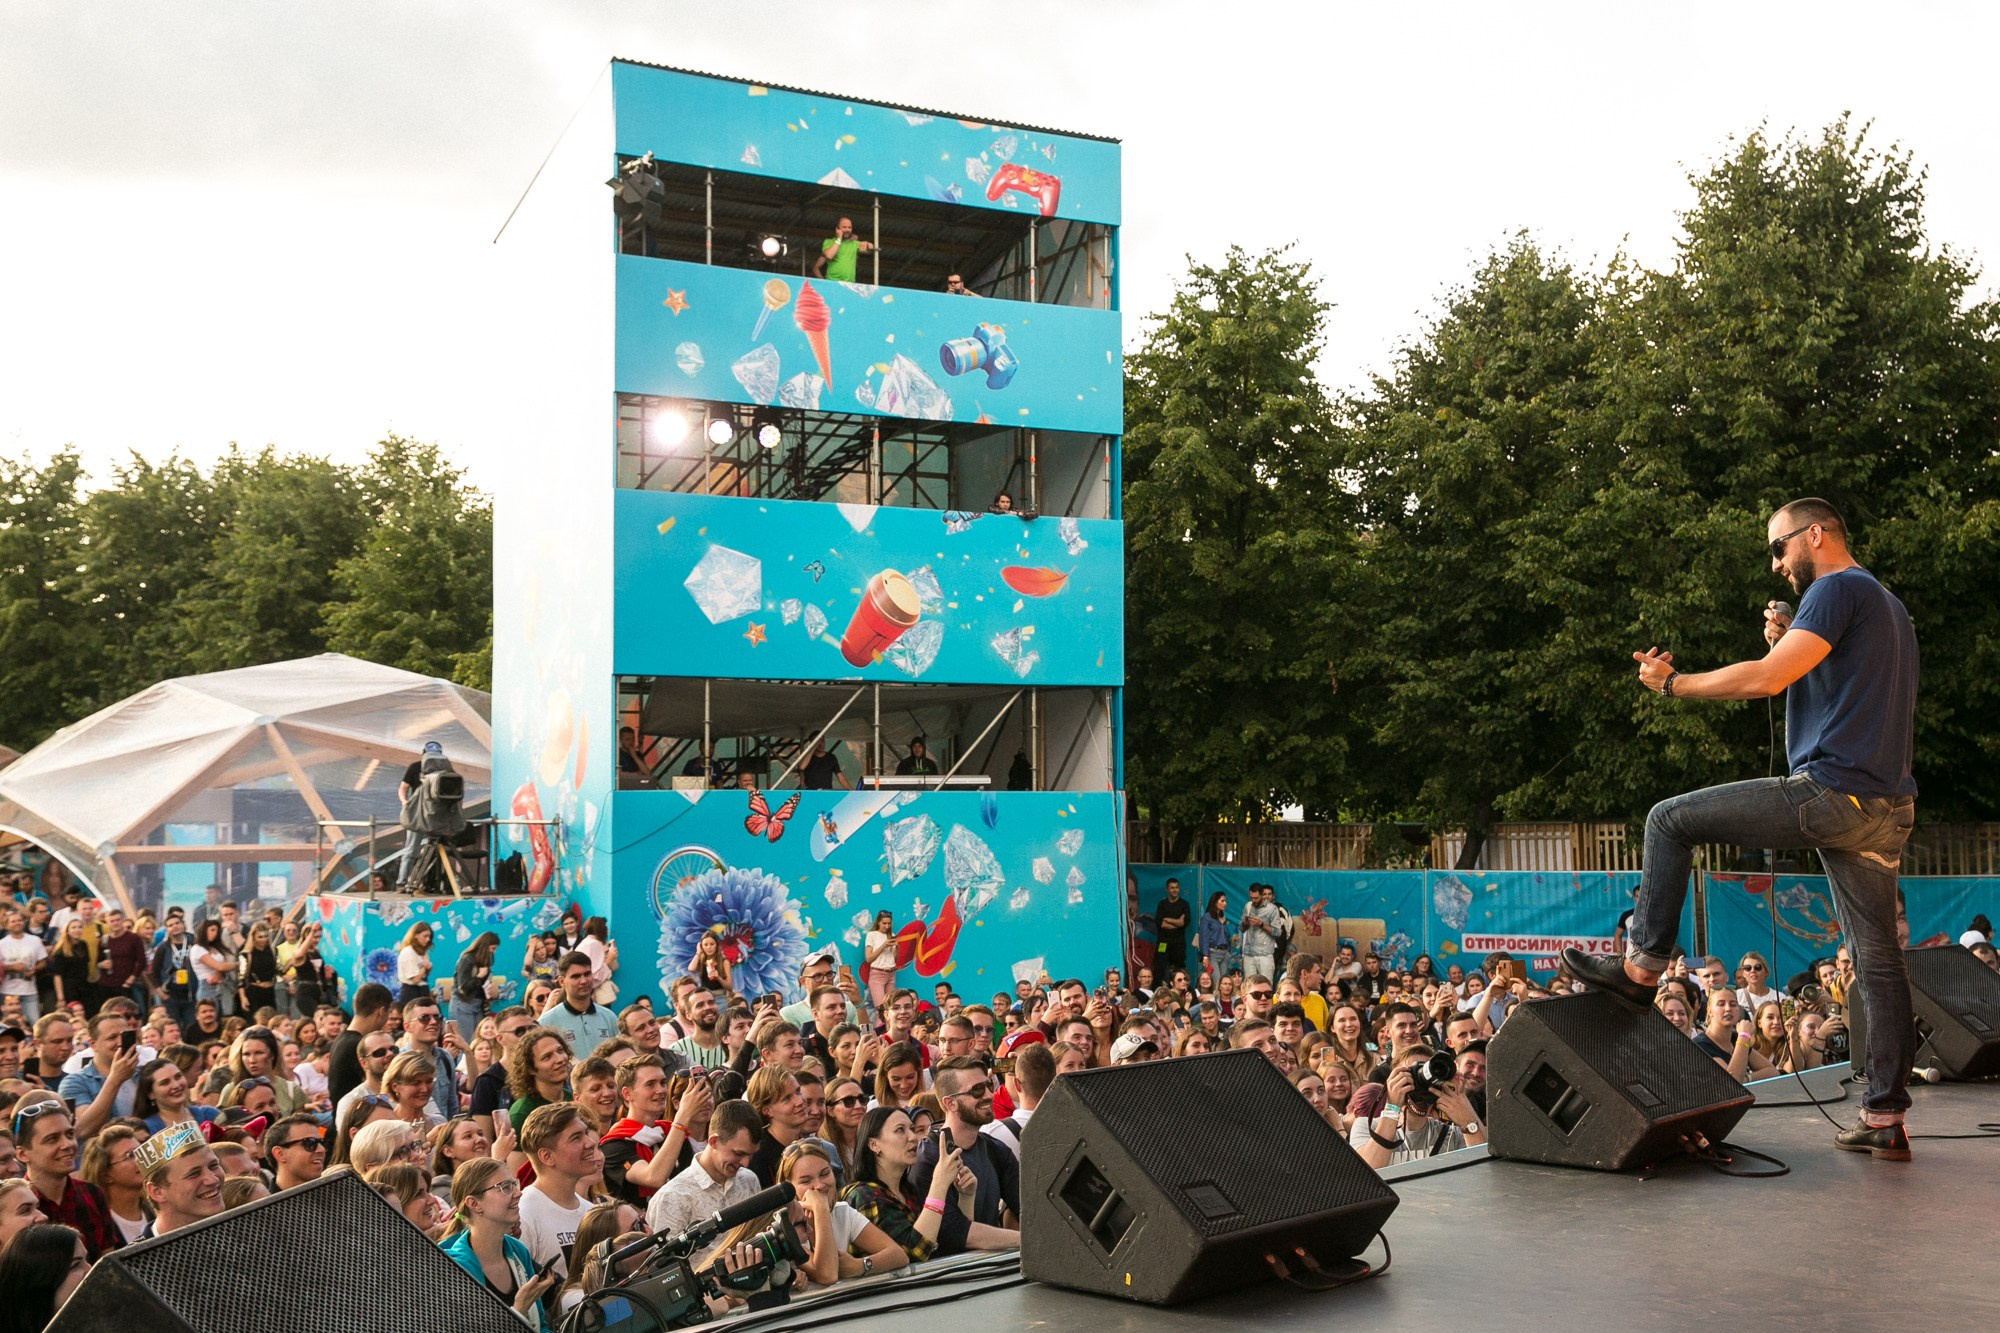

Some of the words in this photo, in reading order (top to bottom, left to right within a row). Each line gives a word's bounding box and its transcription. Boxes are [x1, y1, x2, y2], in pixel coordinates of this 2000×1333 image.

[1464, 936, 1584, 952] ОТПРОСИЛИСЬ
[1587, 940, 1598, 953] У
[1533, 957, 1552, 970] НА
[662, 1273, 680, 1285] SONY
[674, 1288, 682, 1298] 1
